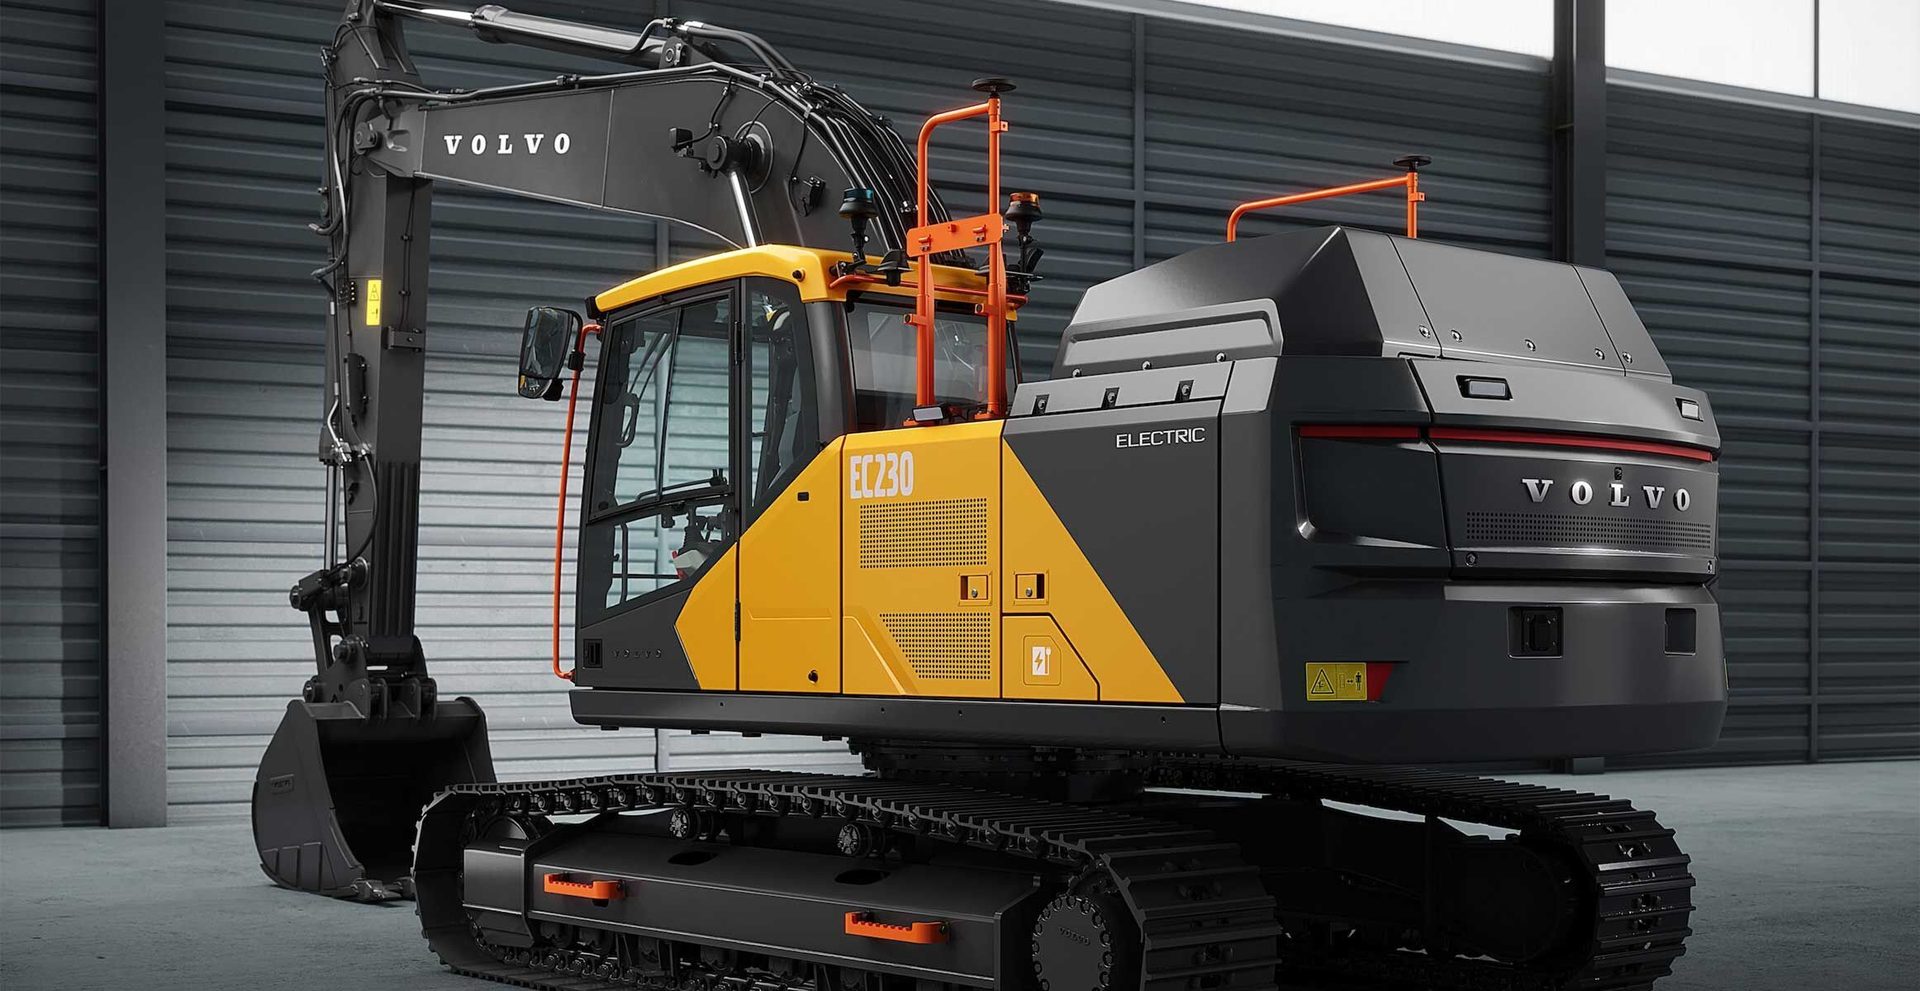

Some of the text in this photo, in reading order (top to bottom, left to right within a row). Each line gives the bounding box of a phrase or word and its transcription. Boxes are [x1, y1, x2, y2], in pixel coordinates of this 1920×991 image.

[444, 133, 571, 155] VOLVO
[1115, 427, 1206, 449] ELECTRIC
[849, 450, 914, 500] EC230
[1522, 478, 1691, 512] VOLVO
